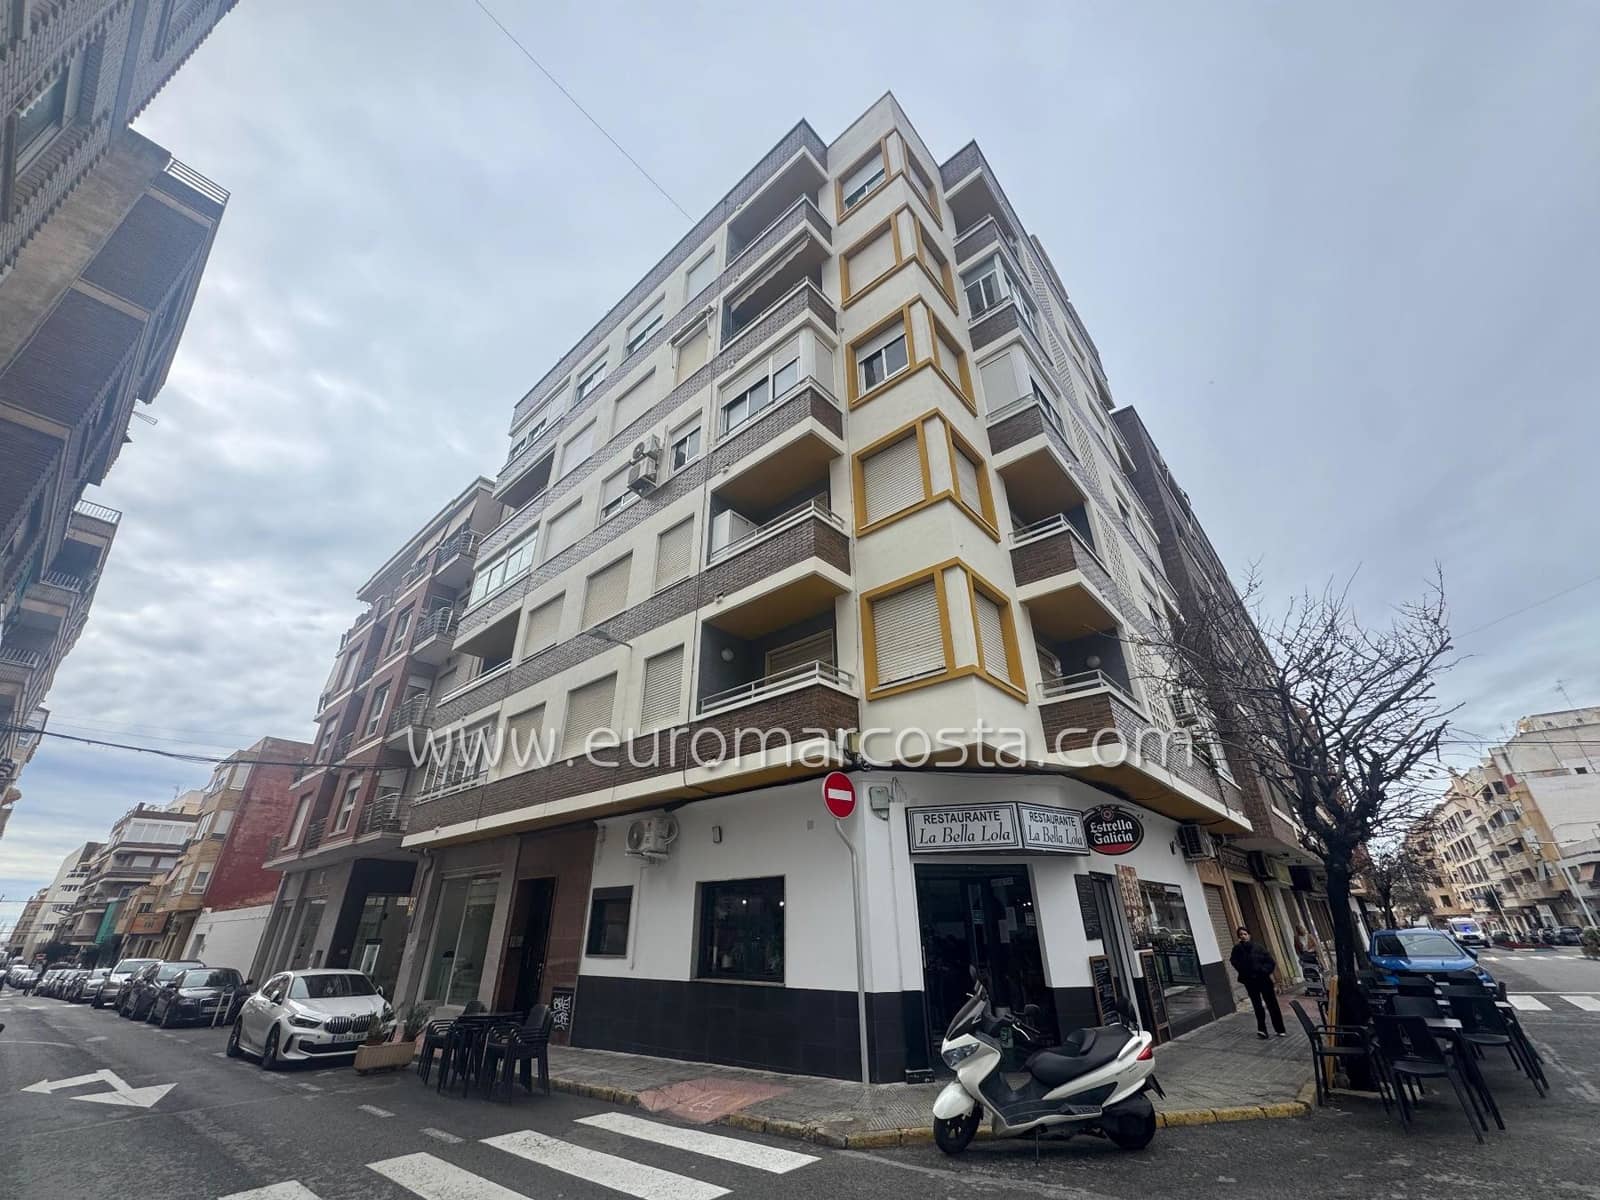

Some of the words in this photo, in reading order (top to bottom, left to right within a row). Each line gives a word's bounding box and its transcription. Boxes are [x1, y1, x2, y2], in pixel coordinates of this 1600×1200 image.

[923, 810, 1001, 825] RESTAURANTE
[1028, 811, 1077, 828] RESTAURANTE
[919, 828, 937, 845] La
[942, 823, 975, 843] Bella
[981, 822, 1011, 842] Lola
[1090, 819, 1133, 834] Estrella
[1028, 825, 1040, 842] La
[1042, 825, 1063, 844] Bella
[1066, 828, 1083, 846] Lola
[1093, 830, 1134, 845] Galicia
